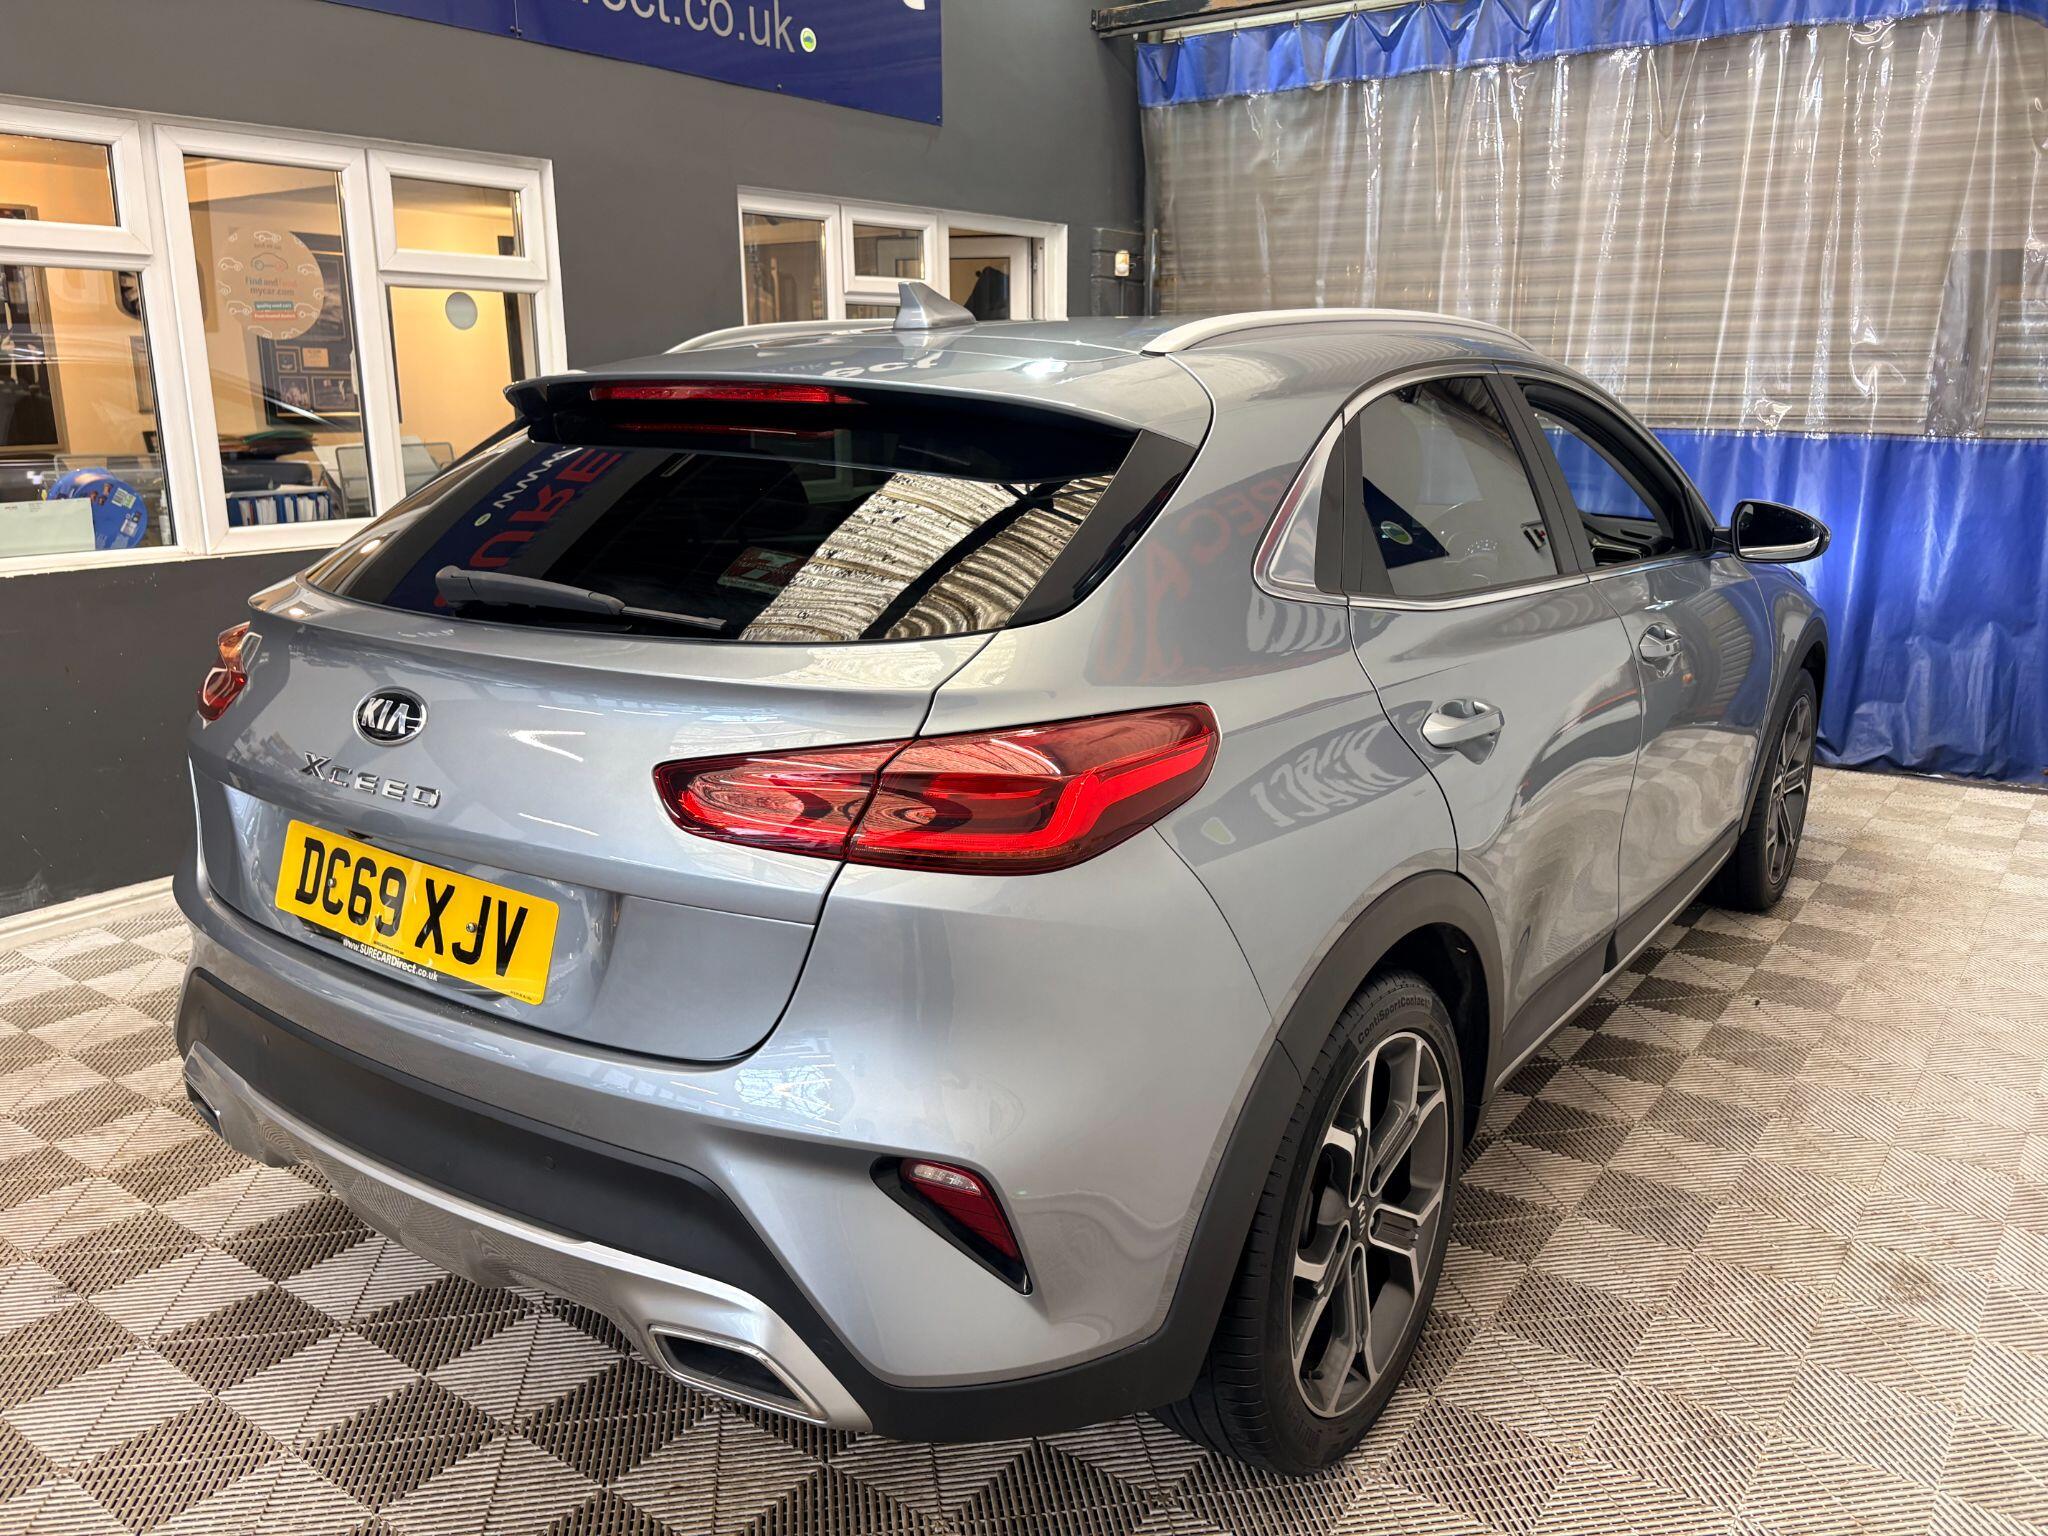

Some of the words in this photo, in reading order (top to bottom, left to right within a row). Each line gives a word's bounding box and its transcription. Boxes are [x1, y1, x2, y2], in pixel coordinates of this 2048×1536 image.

[582, 0, 795, 53] .co.uk
[361, 697, 409, 735] KIA
[301, 751, 441, 808] XCEED
[295, 836, 407, 938] DC69
[414, 877, 529, 977] XJV
[342, 938, 438, 983] www.SURECARDirect.co.uk
